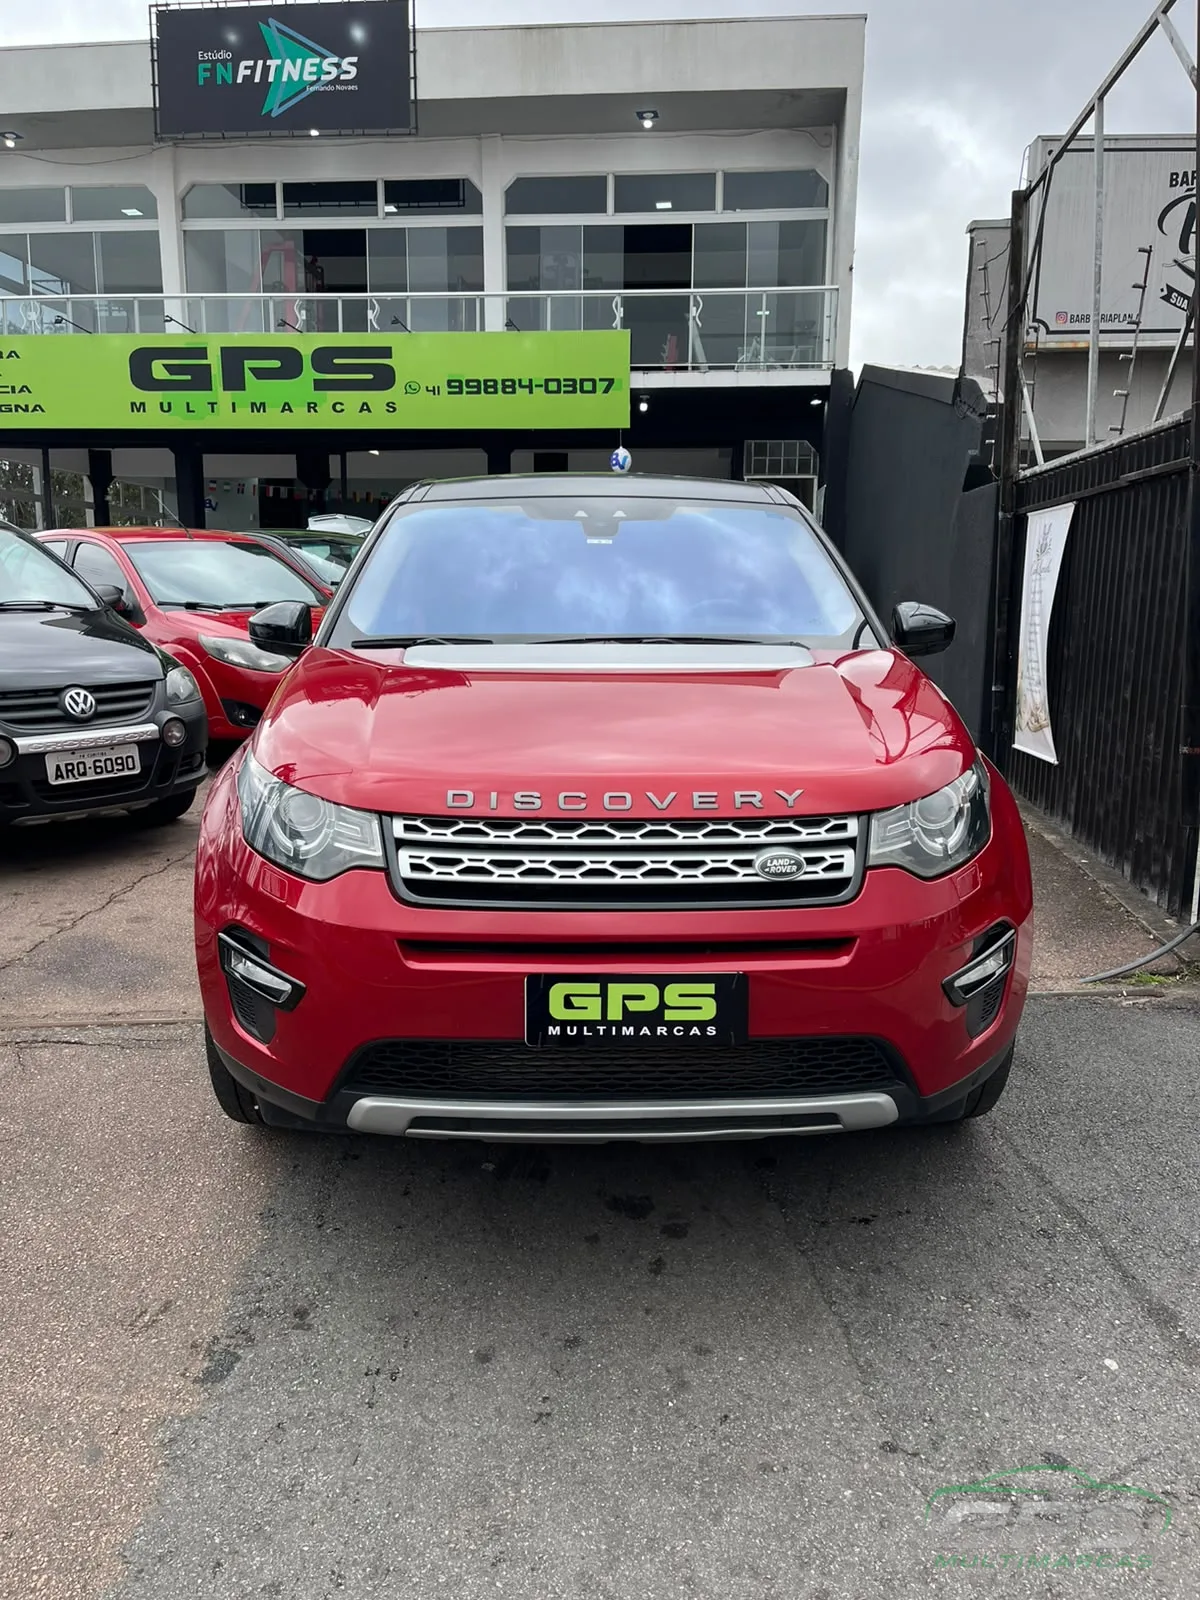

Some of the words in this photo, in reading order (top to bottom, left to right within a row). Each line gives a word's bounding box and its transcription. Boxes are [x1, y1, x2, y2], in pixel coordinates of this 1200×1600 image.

[198, 50, 232, 60] Estúdio
[306, 84, 335, 92] Fernando
[336, 83, 359, 91] Novaes
[129, 346, 397, 391] GPS
[425, 384, 441, 396] 41
[446, 377, 616, 396] 99884-0307
[130, 401, 398, 414] MULTIMARCAS
[446, 789, 805, 811] DISCOVERY
[766, 858, 790, 867] LAND
[769, 865, 798, 874] ROVER
[549, 982, 717, 1021] GPS
[548, 1025, 717, 1036] MULTIMARCAS
